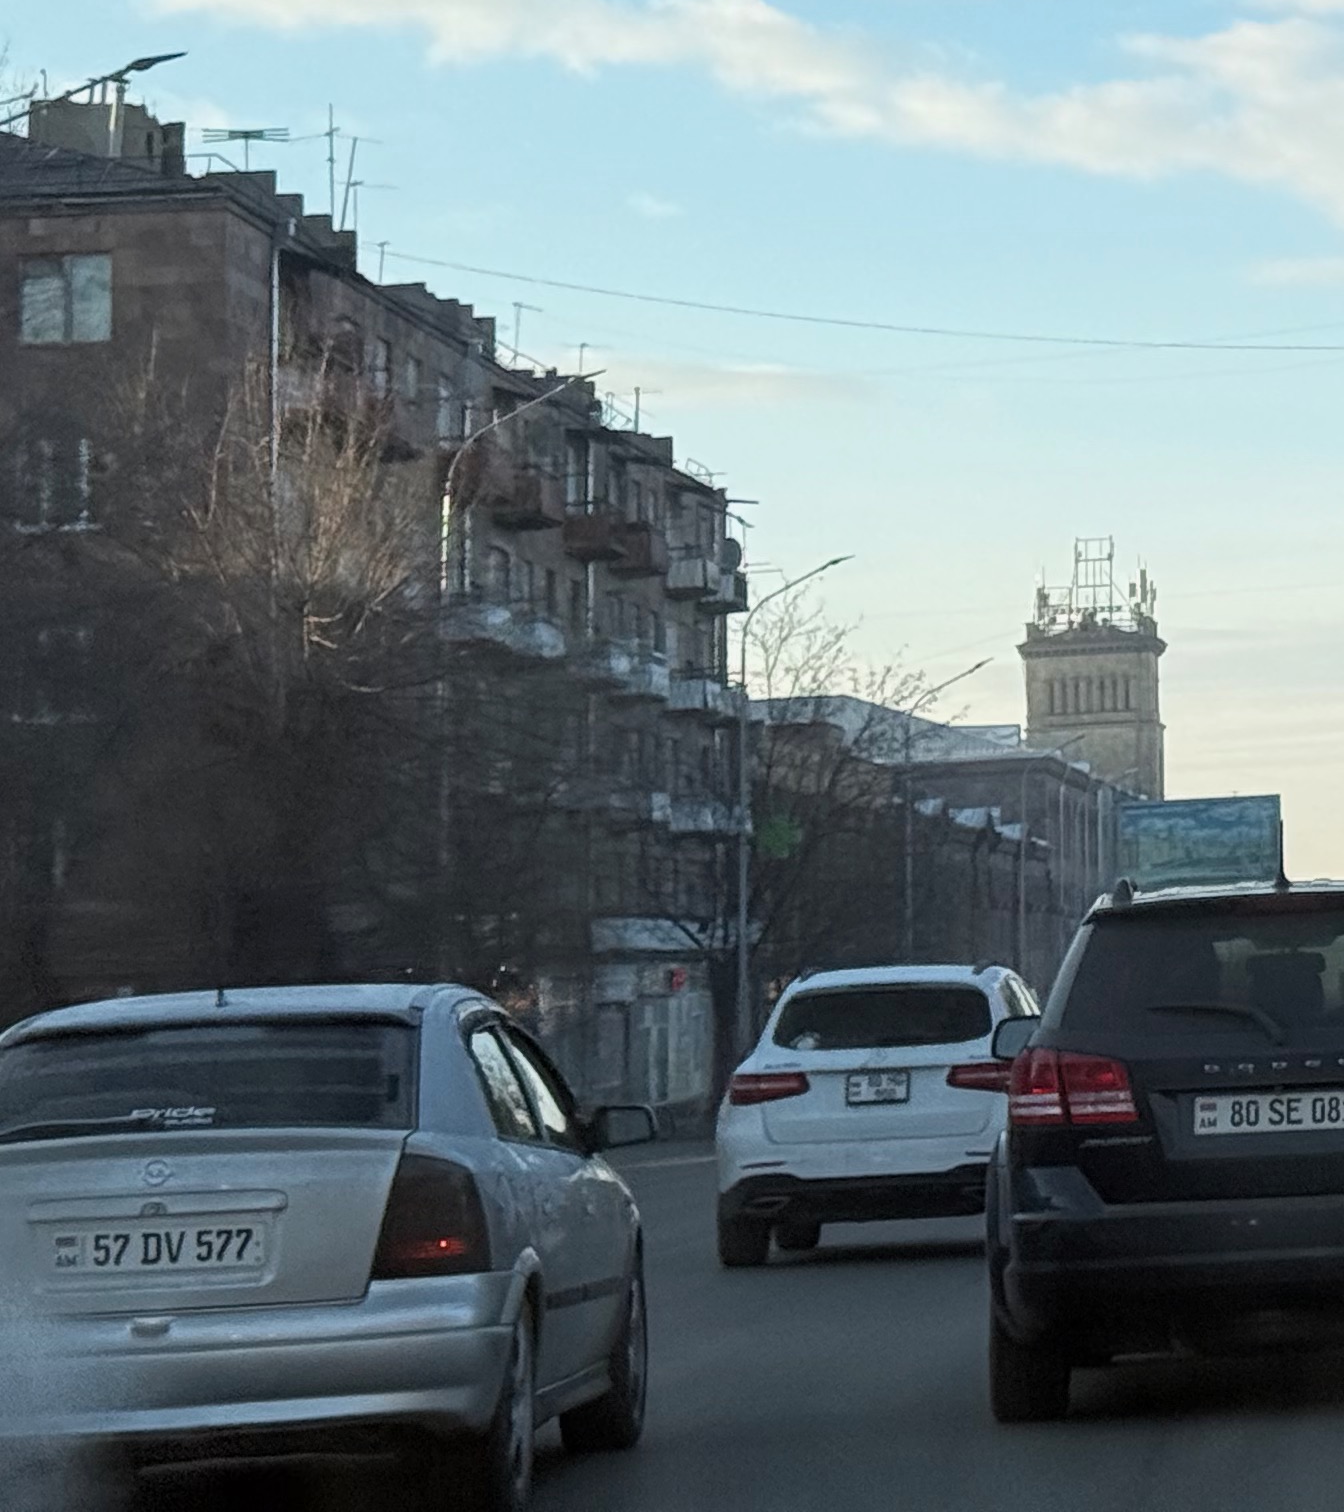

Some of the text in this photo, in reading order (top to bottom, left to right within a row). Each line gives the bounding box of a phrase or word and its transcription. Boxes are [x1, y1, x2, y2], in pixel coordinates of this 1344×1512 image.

[1199, 1117, 1218, 1130] AM
[1230, 1099, 1261, 1128] 80
[1268, 1097, 1303, 1126] SE
[93, 1227, 253, 1267] 57 DV 577
